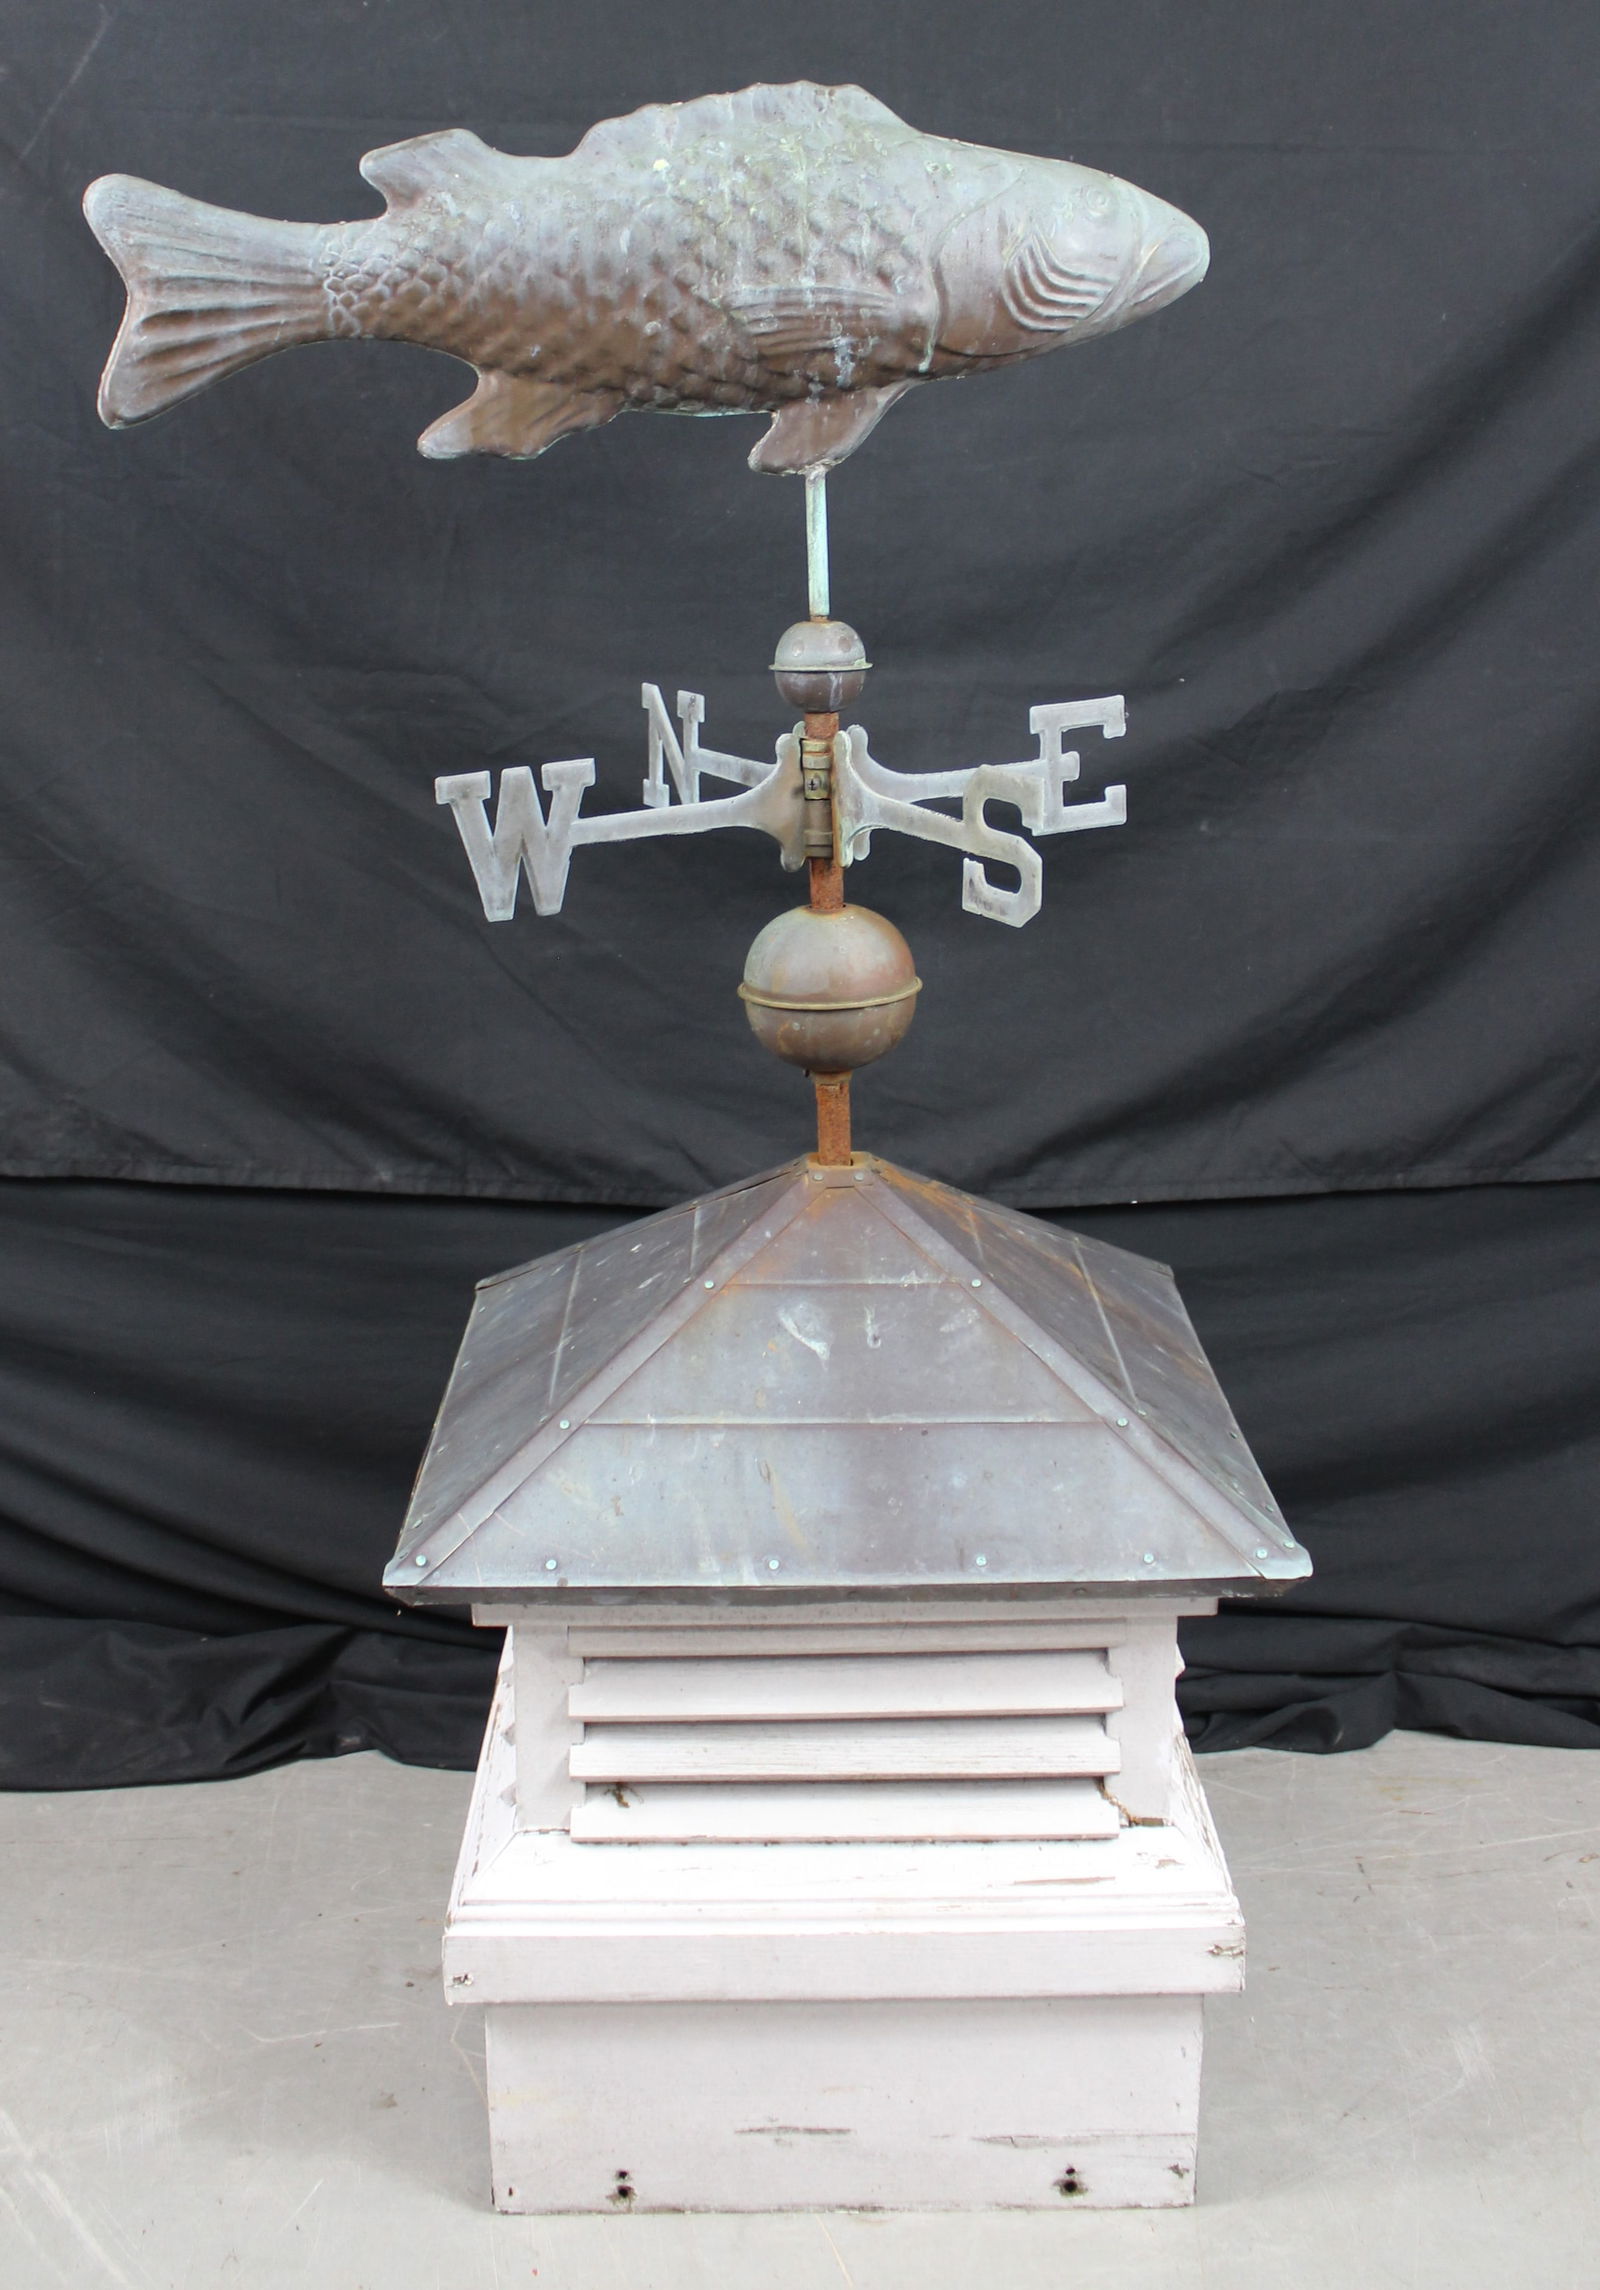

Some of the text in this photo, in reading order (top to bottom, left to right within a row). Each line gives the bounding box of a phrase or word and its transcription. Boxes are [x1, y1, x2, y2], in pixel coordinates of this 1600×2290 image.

[642, 682, 705, 808] N
[1029, 694, 1127, 836] E
[435, 758, 596, 922] W
[962, 764, 1045, 928] S
